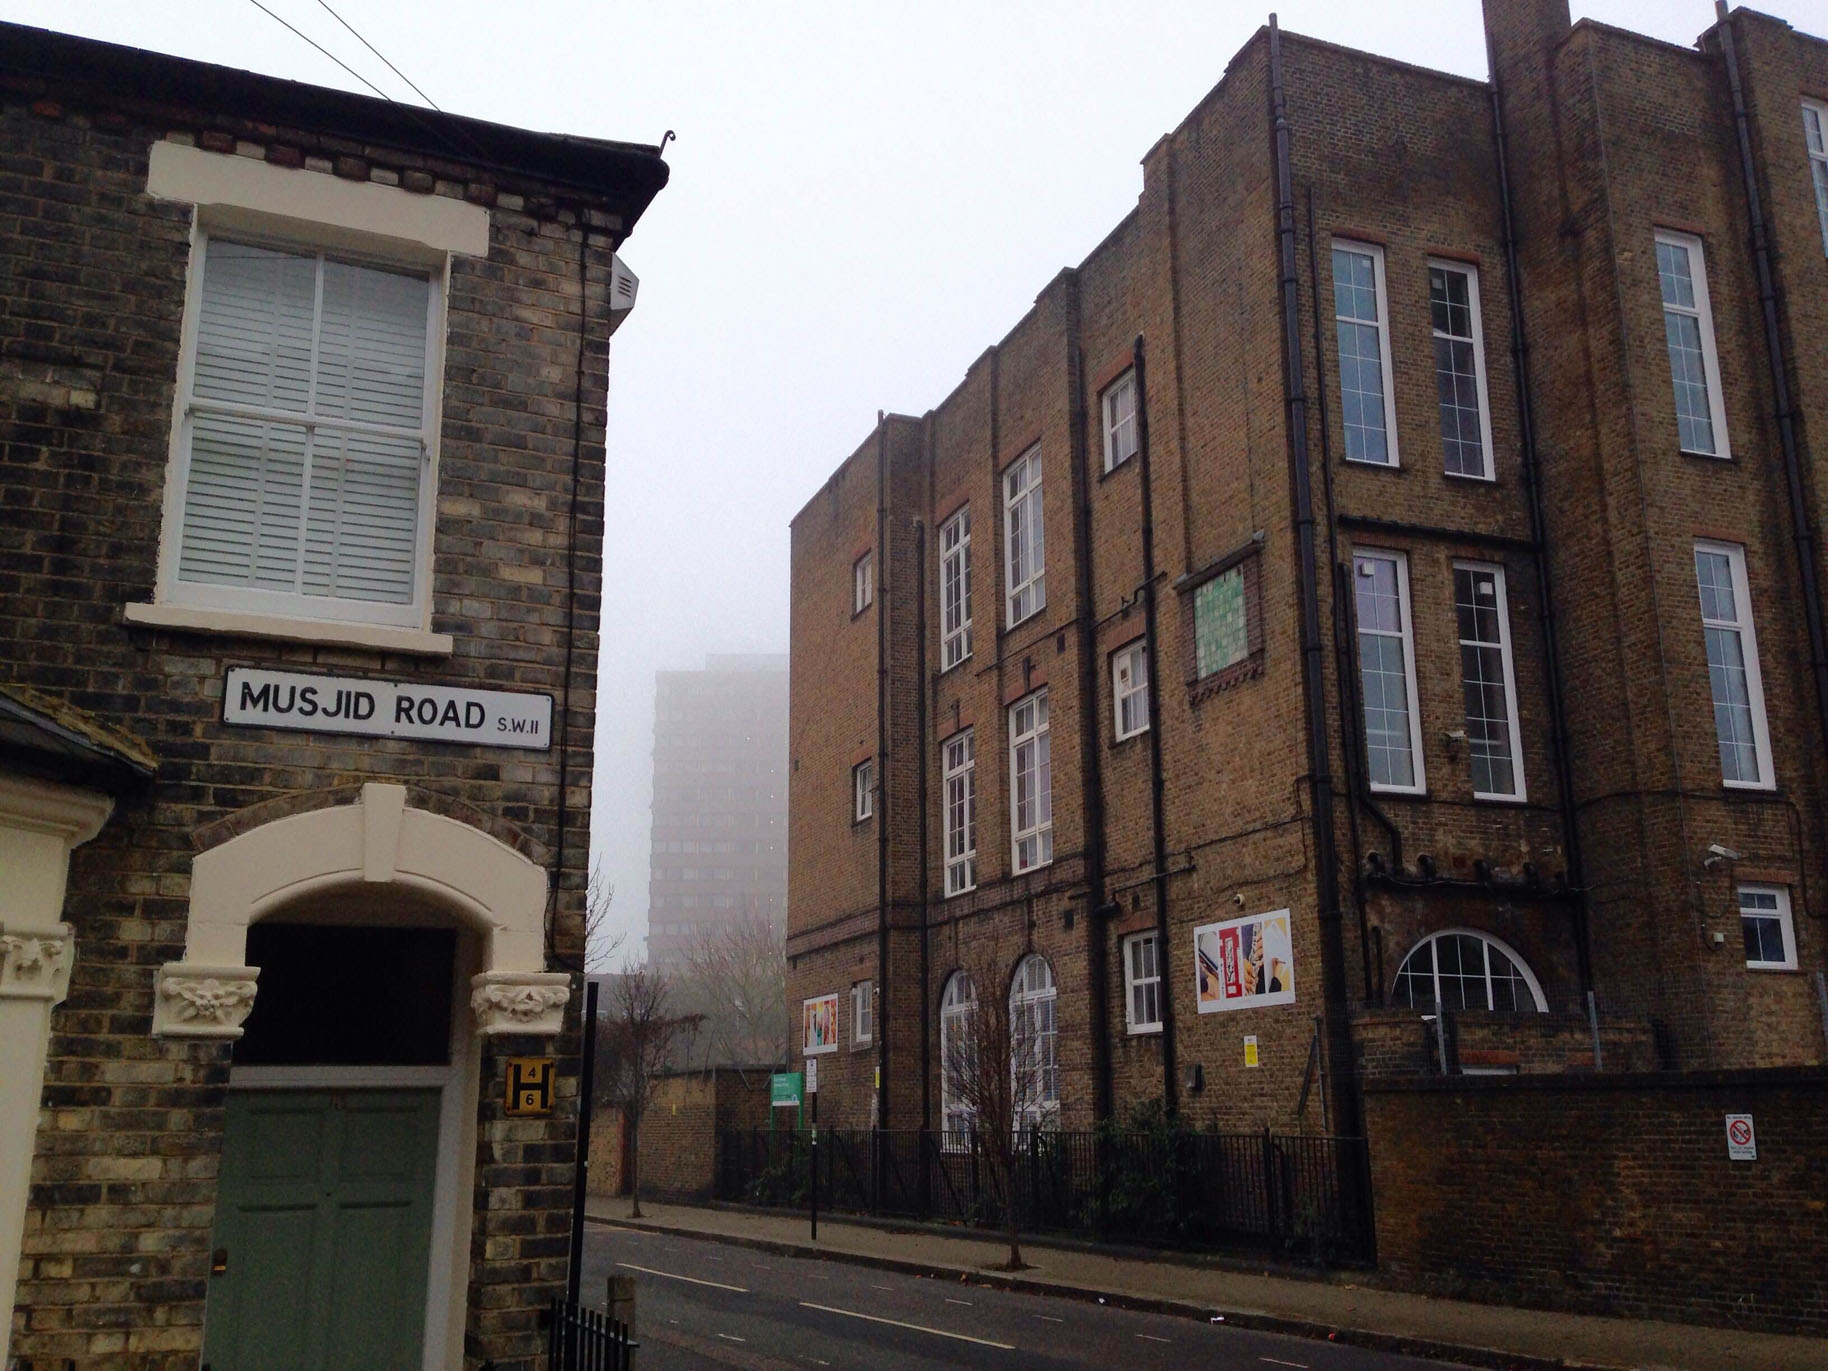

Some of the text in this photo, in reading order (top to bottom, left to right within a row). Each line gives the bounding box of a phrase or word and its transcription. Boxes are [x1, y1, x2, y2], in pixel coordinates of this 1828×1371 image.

[239, 681, 375, 721] MUSJID
[394, 695, 486, 729] ROAD
[512, 1064, 550, 1109] H
[528, 1068, 536, 1078] 4
[526, 1094, 534, 1105] 6
